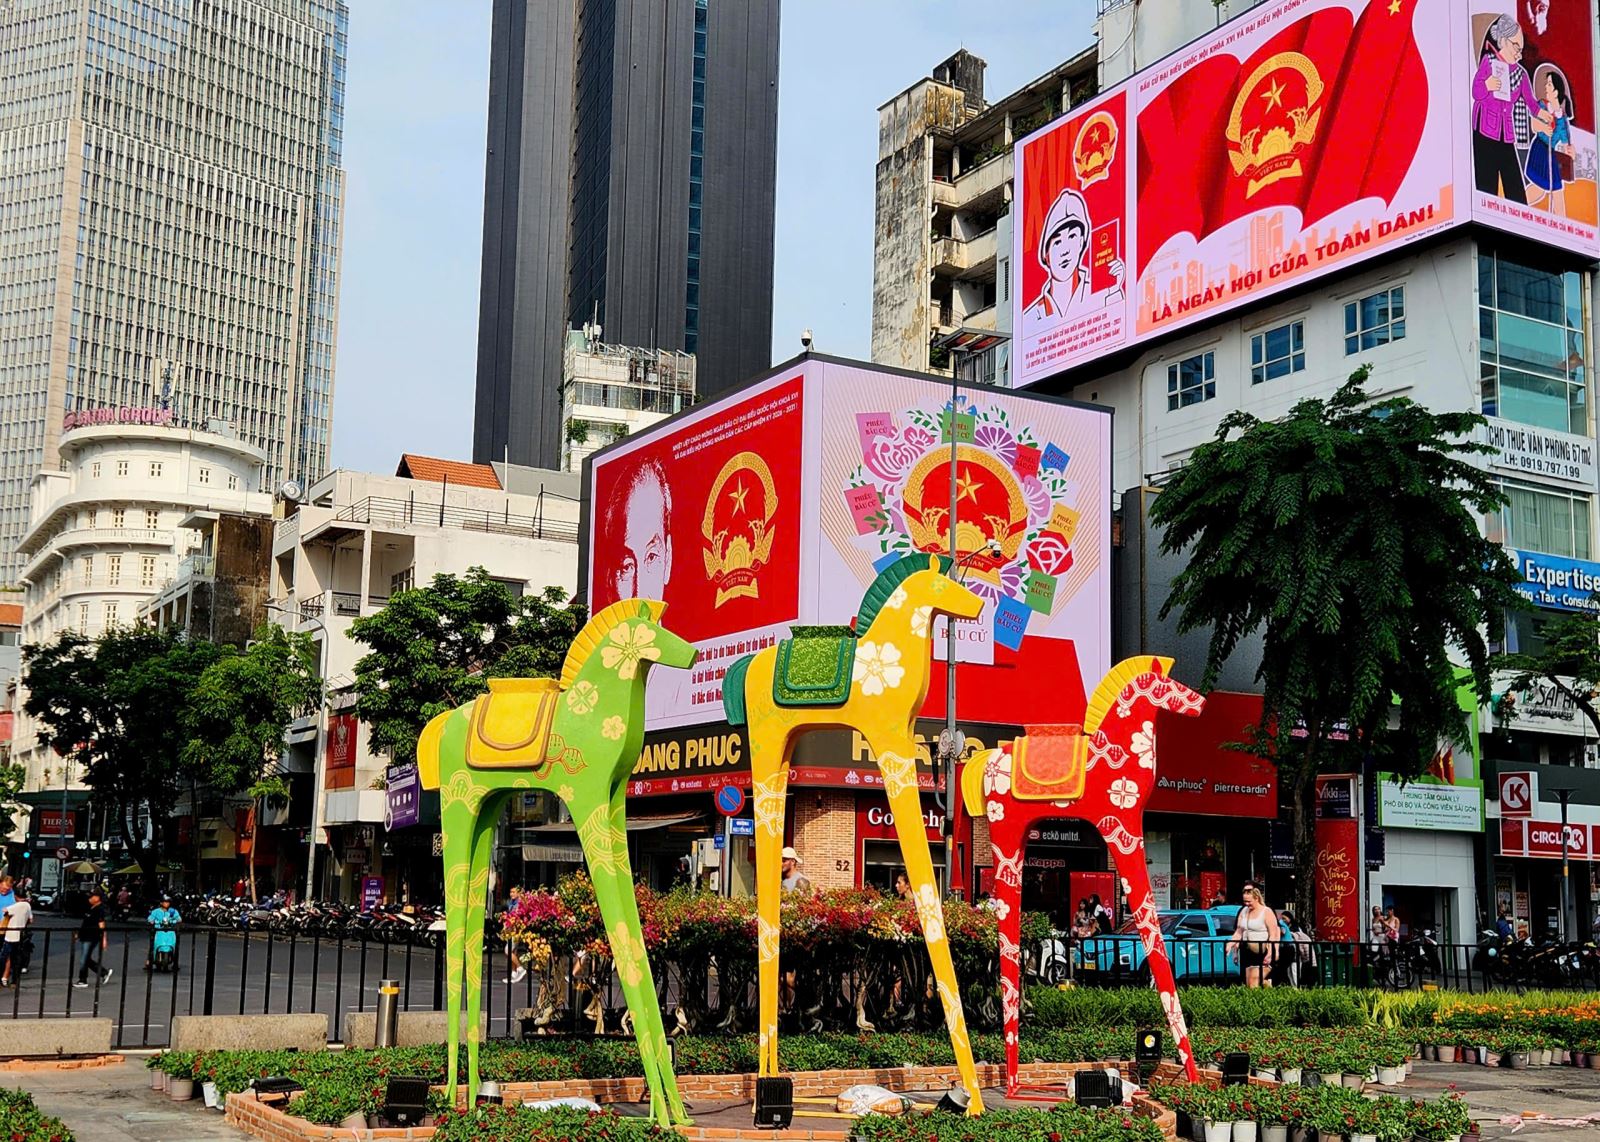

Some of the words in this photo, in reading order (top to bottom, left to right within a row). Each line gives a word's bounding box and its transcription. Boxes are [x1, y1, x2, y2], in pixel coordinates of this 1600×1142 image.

[1152, 304, 1172, 323] LÀ
[1178, 284, 1225, 313] NGÀY
[1231, 270, 1262, 293] HỘI
[1268, 253, 1309, 278] CỦA
[1315, 229, 1370, 261] TOÀN
[1378, 204, 1433, 238] DÂN!
[1488, 425, 1504, 447] CHO
[1506, 428, 1525, 452] THUÊ
[1545, 434, 1570, 461] PHÒNG
[1504, 452, 1518, 466] LH:
[1521, 456, 1580, 478] 0919.797.199
[1526, 560, 1600, 592] Expertise
[1540, 590, 1556, 603] Tax
[969, 629, 988, 643] CỬ
[685, 733, 741, 768] PHUC
[1214, 783, 1240, 793] pierre
[1241, 784, 1267, 794] cardin
[1316, 783, 1338, 798] Vikki
[1403, 792, 1422, 800] TRUNG
[1424, 792, 1435, 800] TÂM
[1440, 803, 1453, 811] VIÊN
[836, 860, 850, 871] 52
[1029, 857, 1065, 868] Kappa
[1324, 916, 1345, 927] 2026
